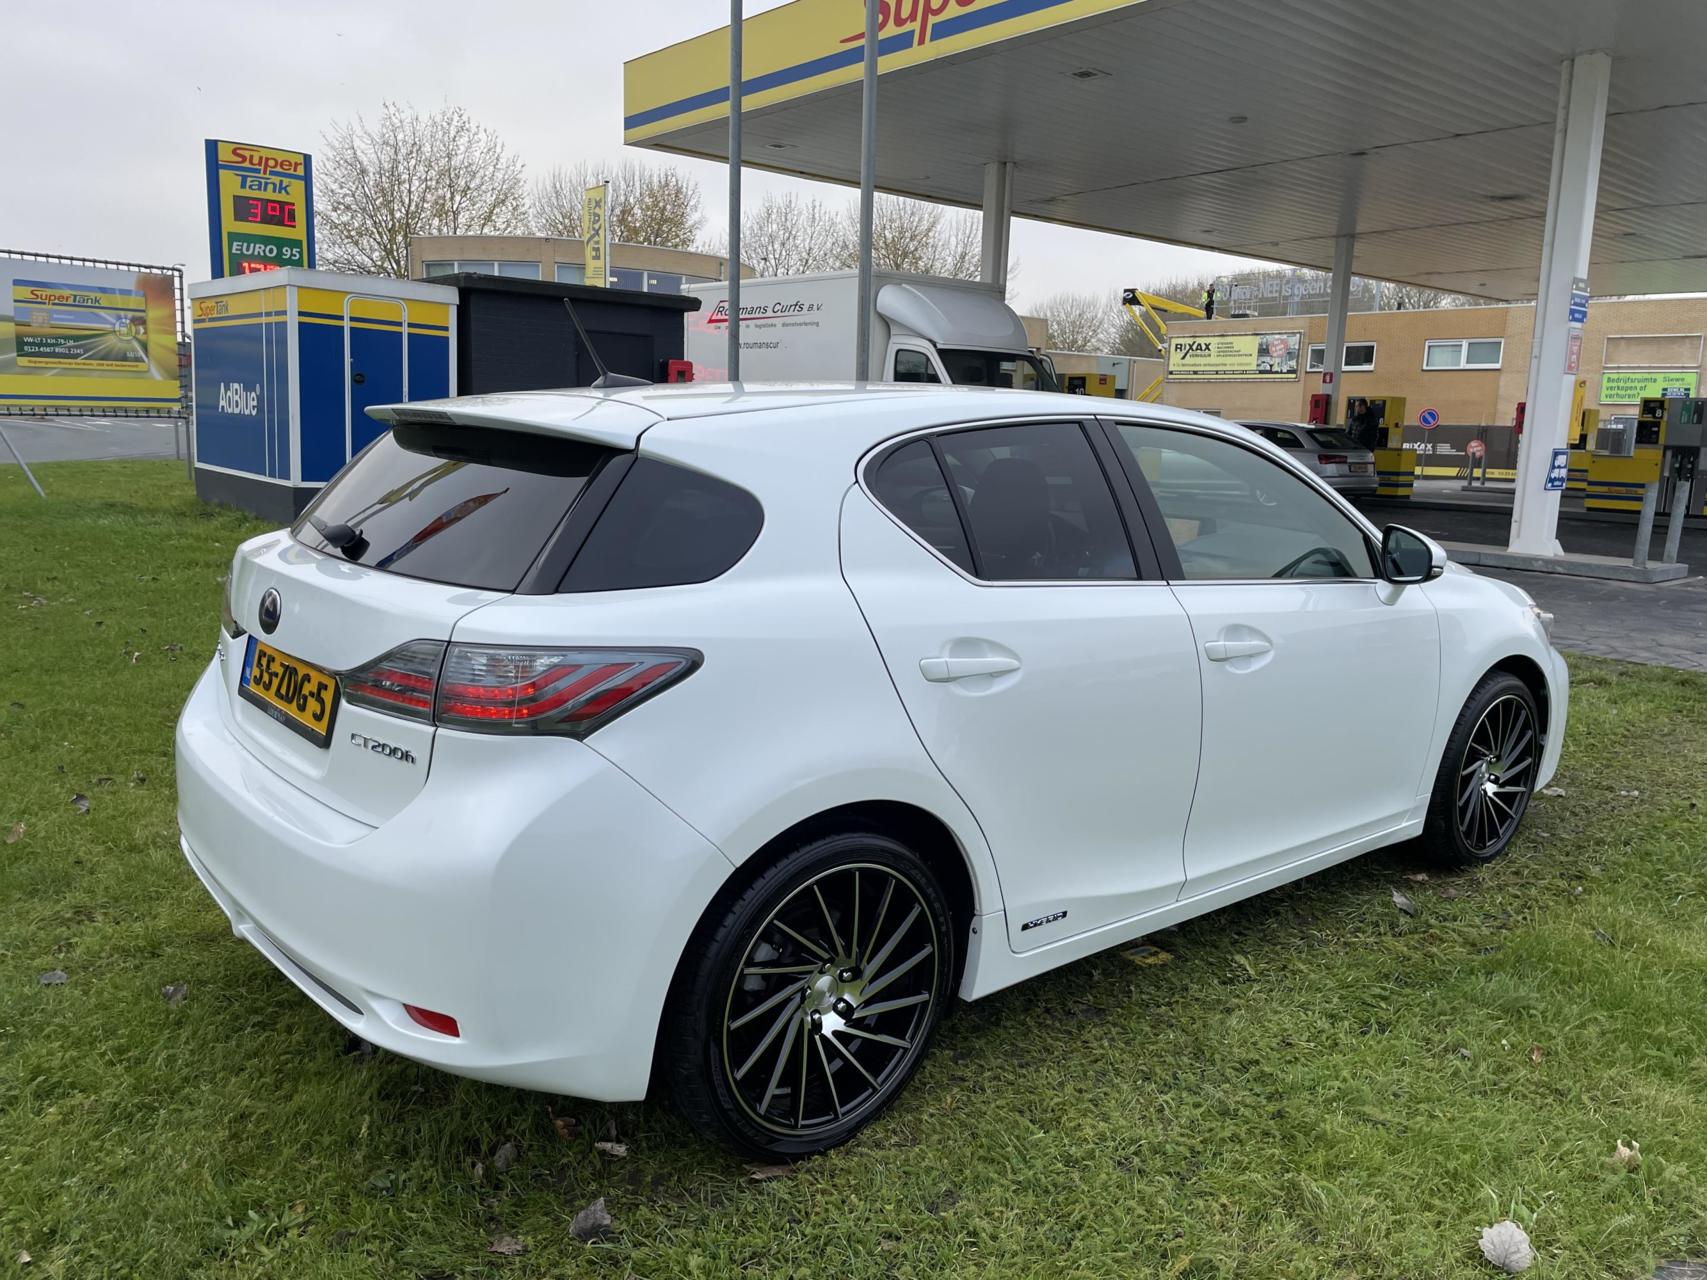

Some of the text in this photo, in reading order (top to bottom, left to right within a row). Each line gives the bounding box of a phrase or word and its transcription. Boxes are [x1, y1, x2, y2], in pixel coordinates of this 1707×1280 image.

[219, 146, 303, 175] Super
[233, 173, 291, 195] Tank
[232, 241, 300, 260] EURO 95
[24, 289, 102, 306] SuperTank
[716, 301, 823, 316] Romans Curfs B.V.
[1175, 341, 1211, 360] RIXAX
[1606, 385, 1637, 393] verkopen
[1607, 376, 1657, 384] Bedrijfsruimte
[1656, 409, 1662, 417] 8
[253, 649, 328, 722] 55-ZDG-5
[351, 732, 416, 765] CT200h
